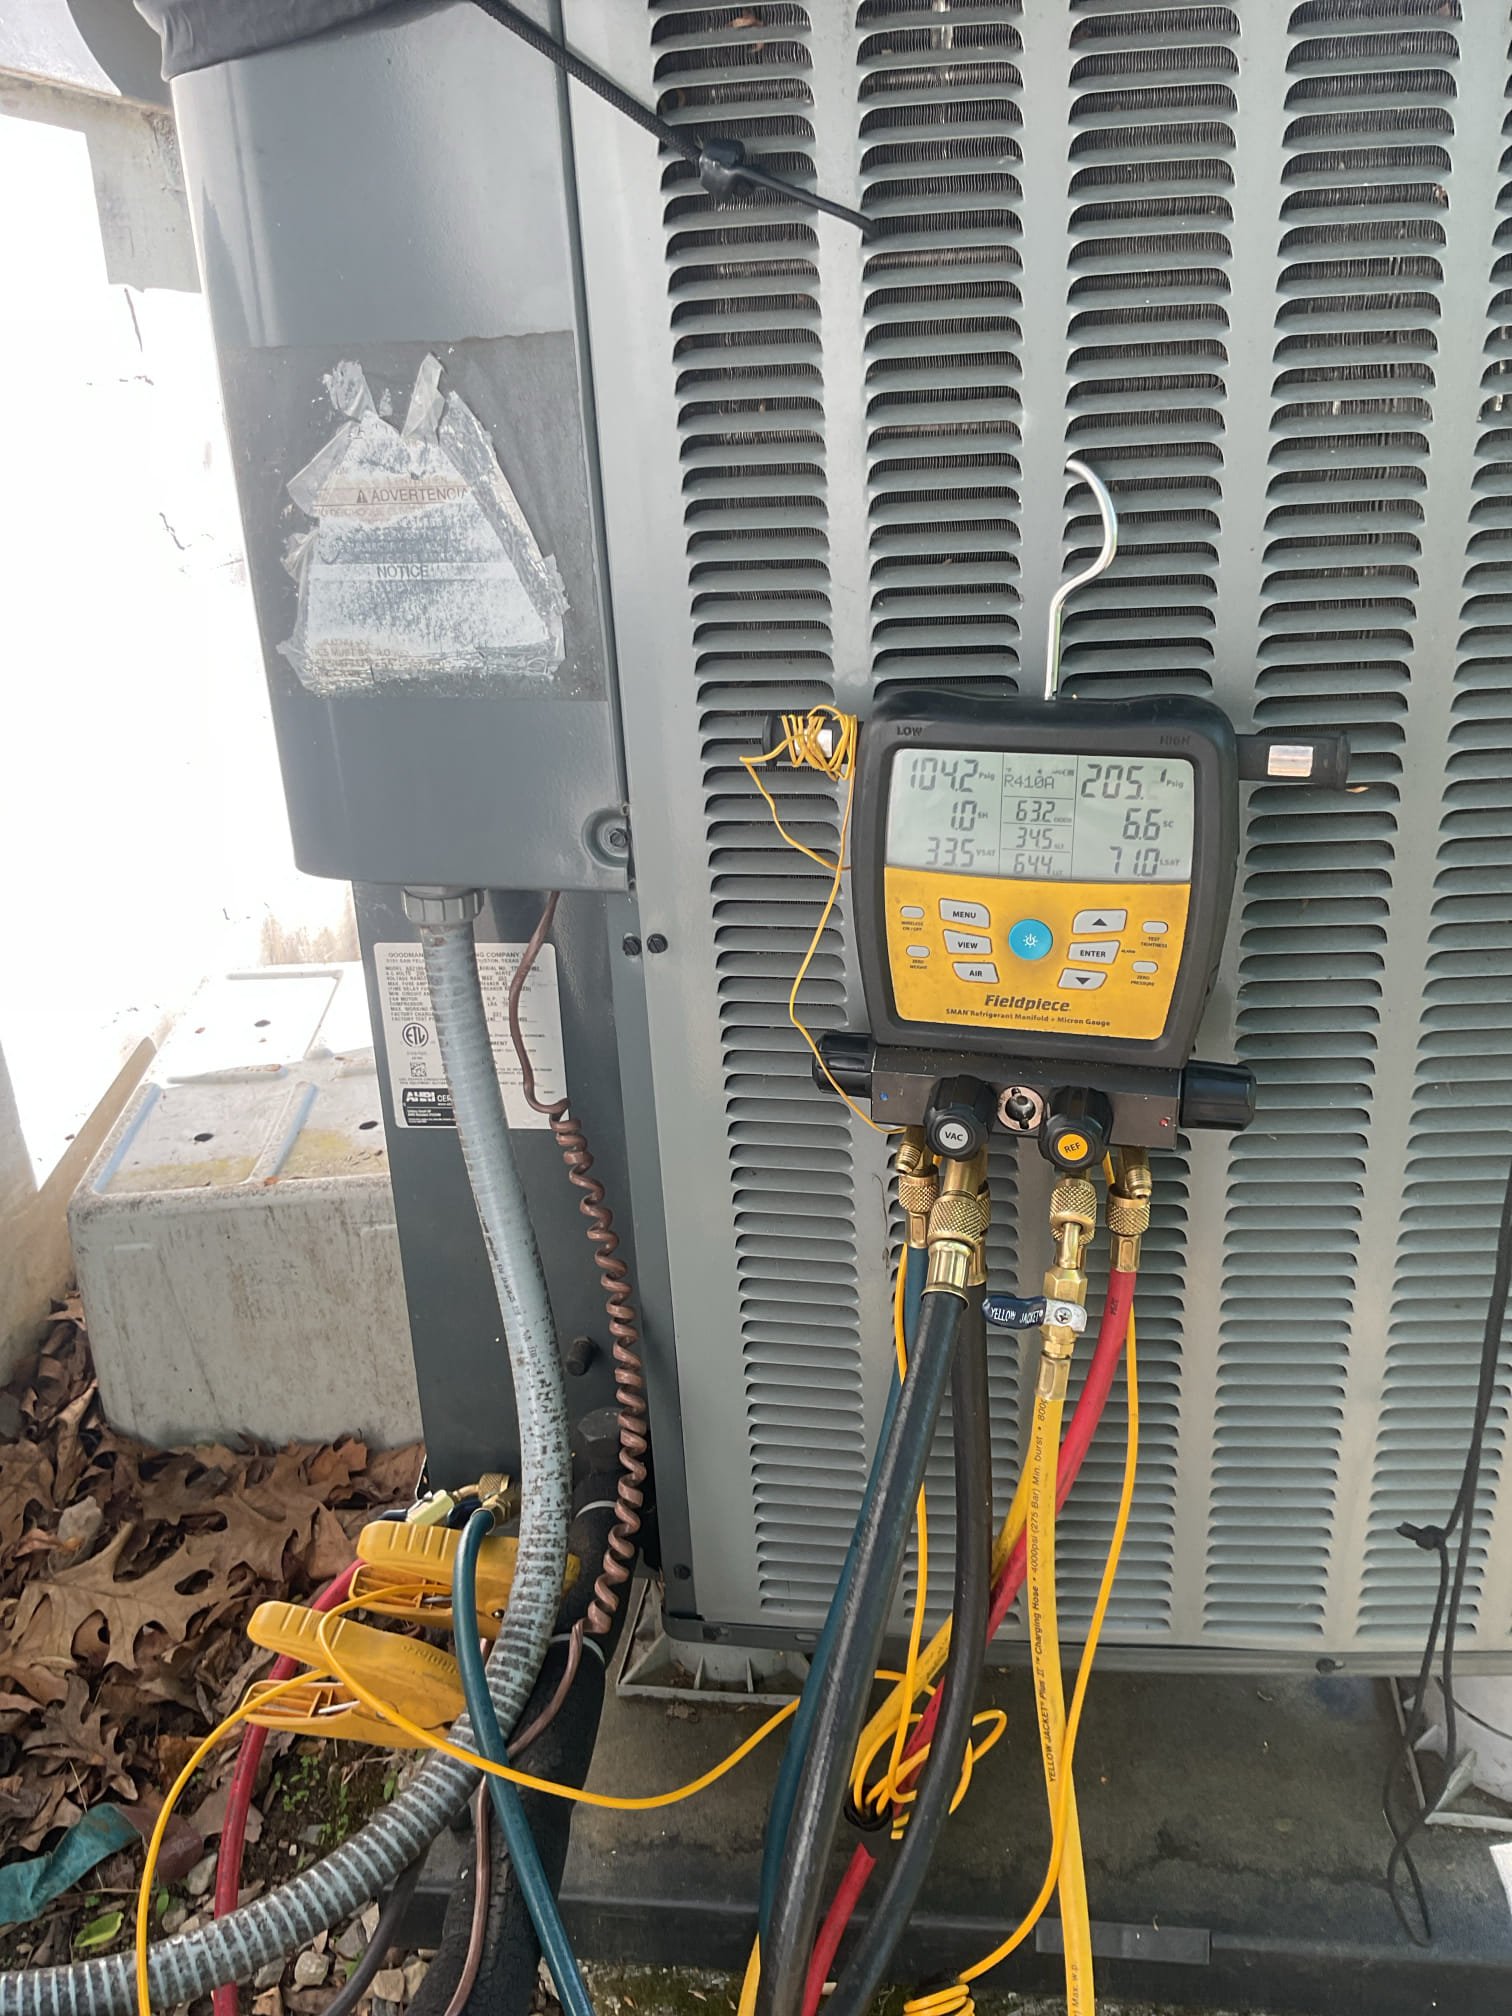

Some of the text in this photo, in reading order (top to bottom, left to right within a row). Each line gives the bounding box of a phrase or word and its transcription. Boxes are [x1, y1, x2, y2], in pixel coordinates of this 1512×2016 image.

[377, 565, 430, 579] NOTICE
[897, 726, 923, 737] LOW
[1160, 735, 1191, 746] HIGH
[910, 758, 979, 793] 104.2
[1003, 775, 1055, 789] R410A
[1166, 780, 1184, 789] Psig
[951, 800, 988, 831] 1.0 SH
[1122, 808, 1174, 841] 6.6 SC
[976, 849, 995, 857] VSAT
[1110, 846, 1161, 877] 71.0
[952, 910, 977, 919] MENU
[957, 941, 978, 949] VIEW
[1080, 950, 1106, 958] ENTER
[969, 969, 983, 977] AIR
[984, 994, 1070, 1012] Fieldpiece
[970, 1010, 1013, 1020] Refrigerant
[1014, 1013, 1049, 1022] Manifold
[1057, 1016, 1084, 1024] Micron
[1085, 1018, 1111, 1027] Gauge
[405, 1026, 426, 1045] ETL
[406, 1091, 435, 1102] AHRI
[944, 1132, 963, 1142] VAC
[1063, 1143, 1081, 1153] REF
[990, 1306, 1016, 1322] YELLOW
[1035, 1437, 1043, 1461] burst
[1031, 1488, 1041, 1509] Bar)
[1031, 1512, 1039, 1533] (275
[1031, 1536, 1039, 1573] 4000psi
[1031, 1585, 1040, 1609] Hose
[1032, 1613, 1043, 1655] Charging
[1038, 1680, 1047, 1700] Plus
[1046, 1743, 1057, 1782] YELLOW
